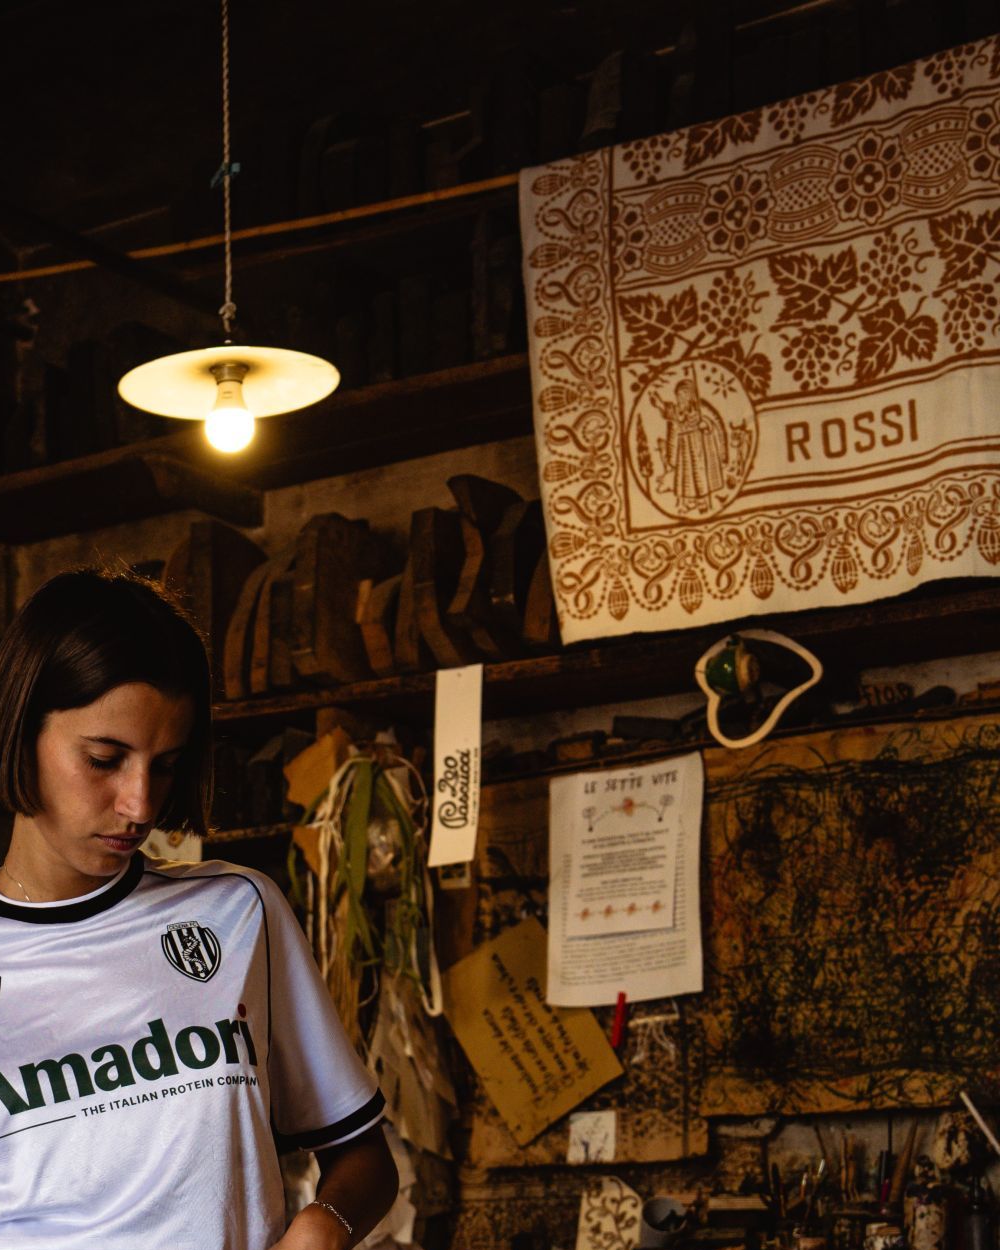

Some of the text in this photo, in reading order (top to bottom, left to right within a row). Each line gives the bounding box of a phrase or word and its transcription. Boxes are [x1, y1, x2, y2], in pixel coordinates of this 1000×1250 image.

[785, 399, 918, 462] ROSSI
[438, 748, 471, 830] Pascucci
[81, 1076, 259, 1118] THE ITALIAN PROTEIN COMPAN
